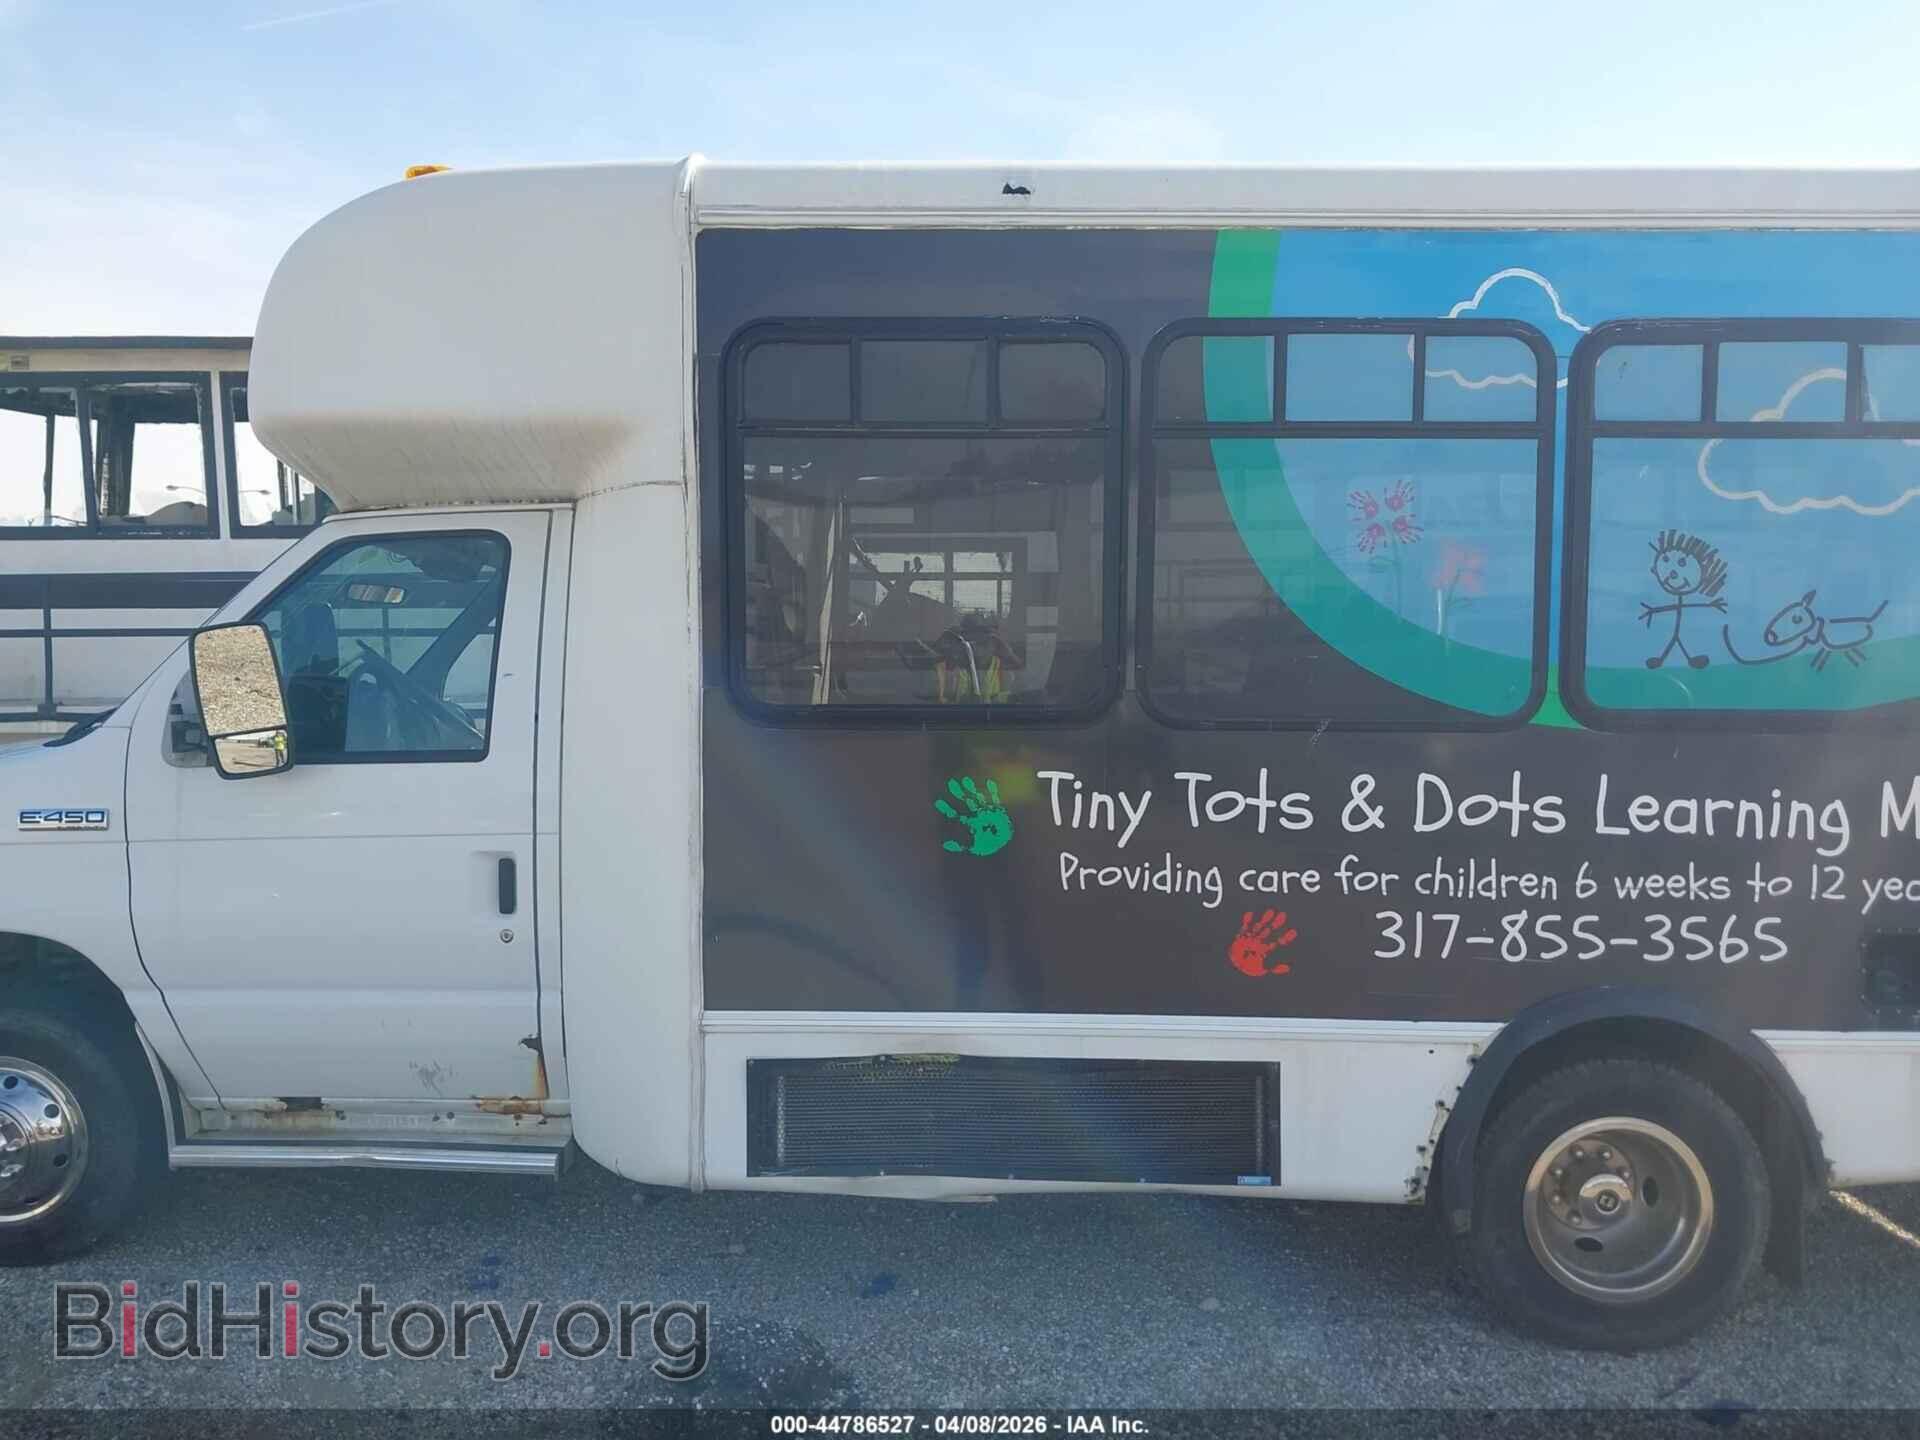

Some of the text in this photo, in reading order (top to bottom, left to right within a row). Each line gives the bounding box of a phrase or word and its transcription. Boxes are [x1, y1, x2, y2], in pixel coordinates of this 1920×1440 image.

[20, 810, 105, 823] E-450
[1036, 770, 1152, 849] Tiny
[1174, 767, 1314, 834] Tots
[1341, 773, 1385, 833] &
[1413, 770, 1566, 838] Dots
[1595, 773, 1850, 857] Learning
[1060, 852, 1223, 909] Providing
[1239, 869, 1321, 894] care
[1333, 854, 1400, 896] for
[1414, 856, 1557, 901] children
[1575, 861, 1597, 899] 6
[1614, 861, 1731, 901] weeks
[1746, 861, 1793, 903] to
[1810, 863, 1846, 900] 12
[1374, 909, 1788, 964] 317-855-3565
